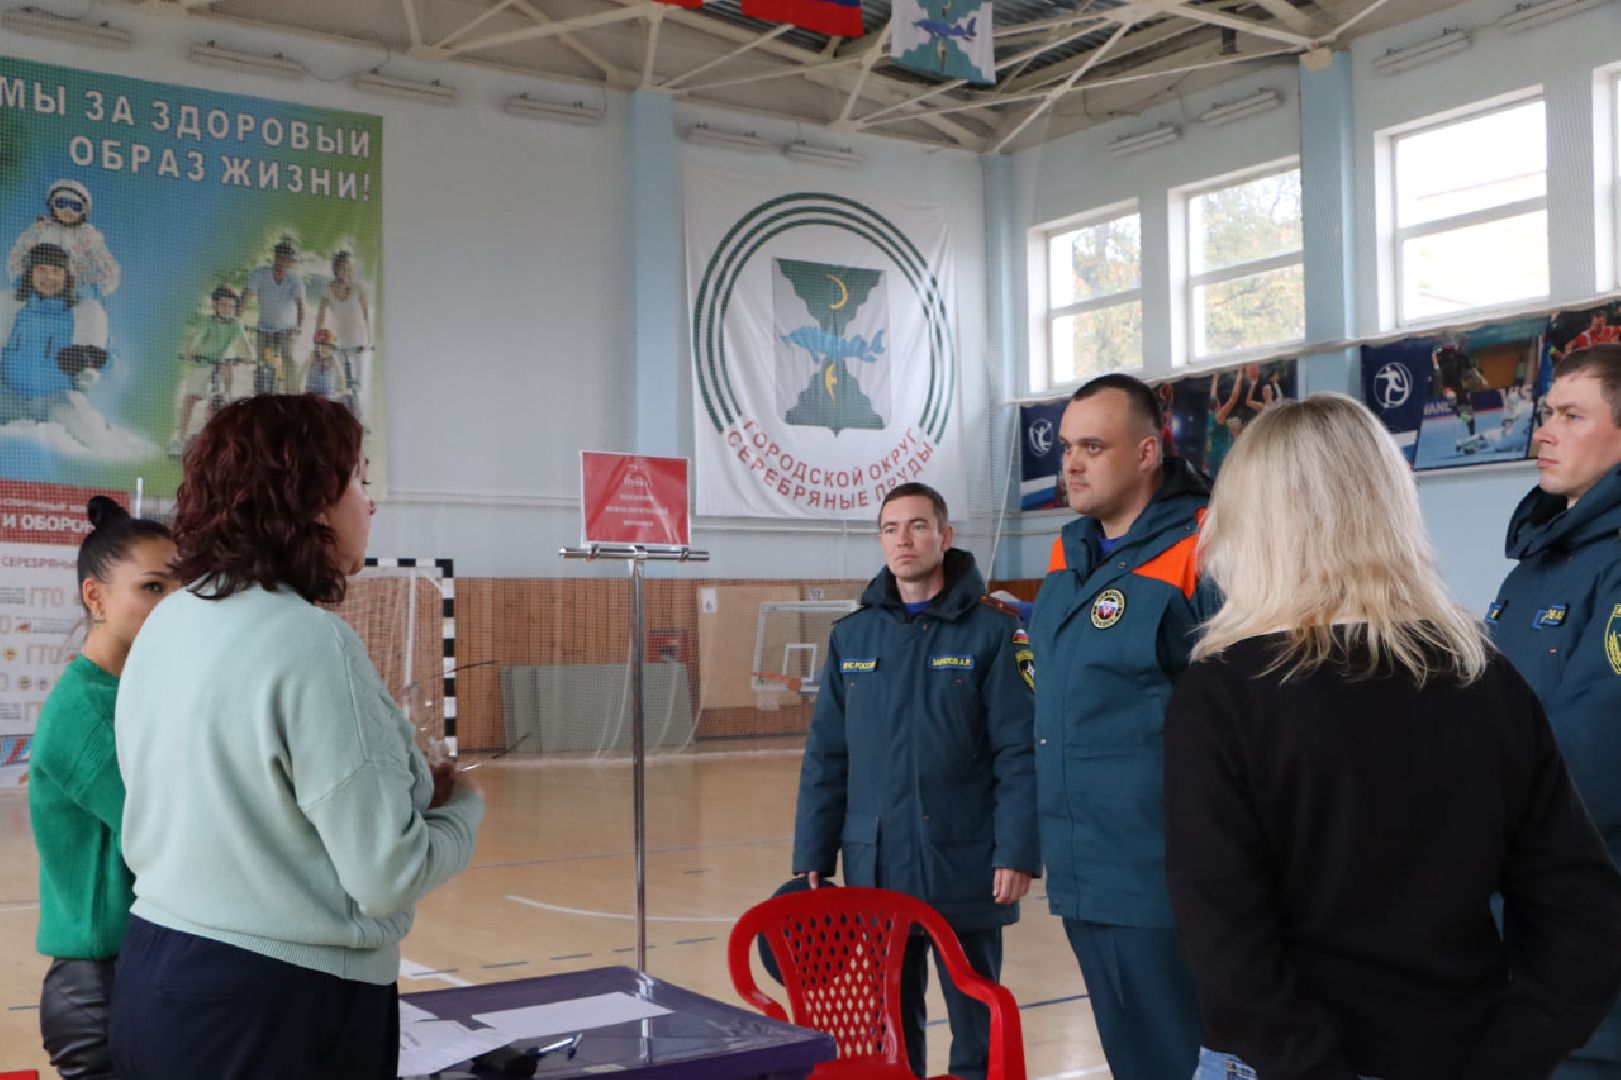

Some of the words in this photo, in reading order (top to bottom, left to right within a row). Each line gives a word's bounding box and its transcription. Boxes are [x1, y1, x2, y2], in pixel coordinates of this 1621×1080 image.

[0, 76, 66, 116] МЫ
[85, 90, 135, 126] ЗА
[69, 135, 206, 182] ОБРАЗ
[221, 155, 371, 201] ЖИЗНИ!
[728, 430, 869, 510] СЕРЕБРЯНЫЕ
[743, 421, 864, 488] ГОРОДСКОЙ
[869, 427, 916, 480] ОКРУГ
[2, 513, 17, 528] И
